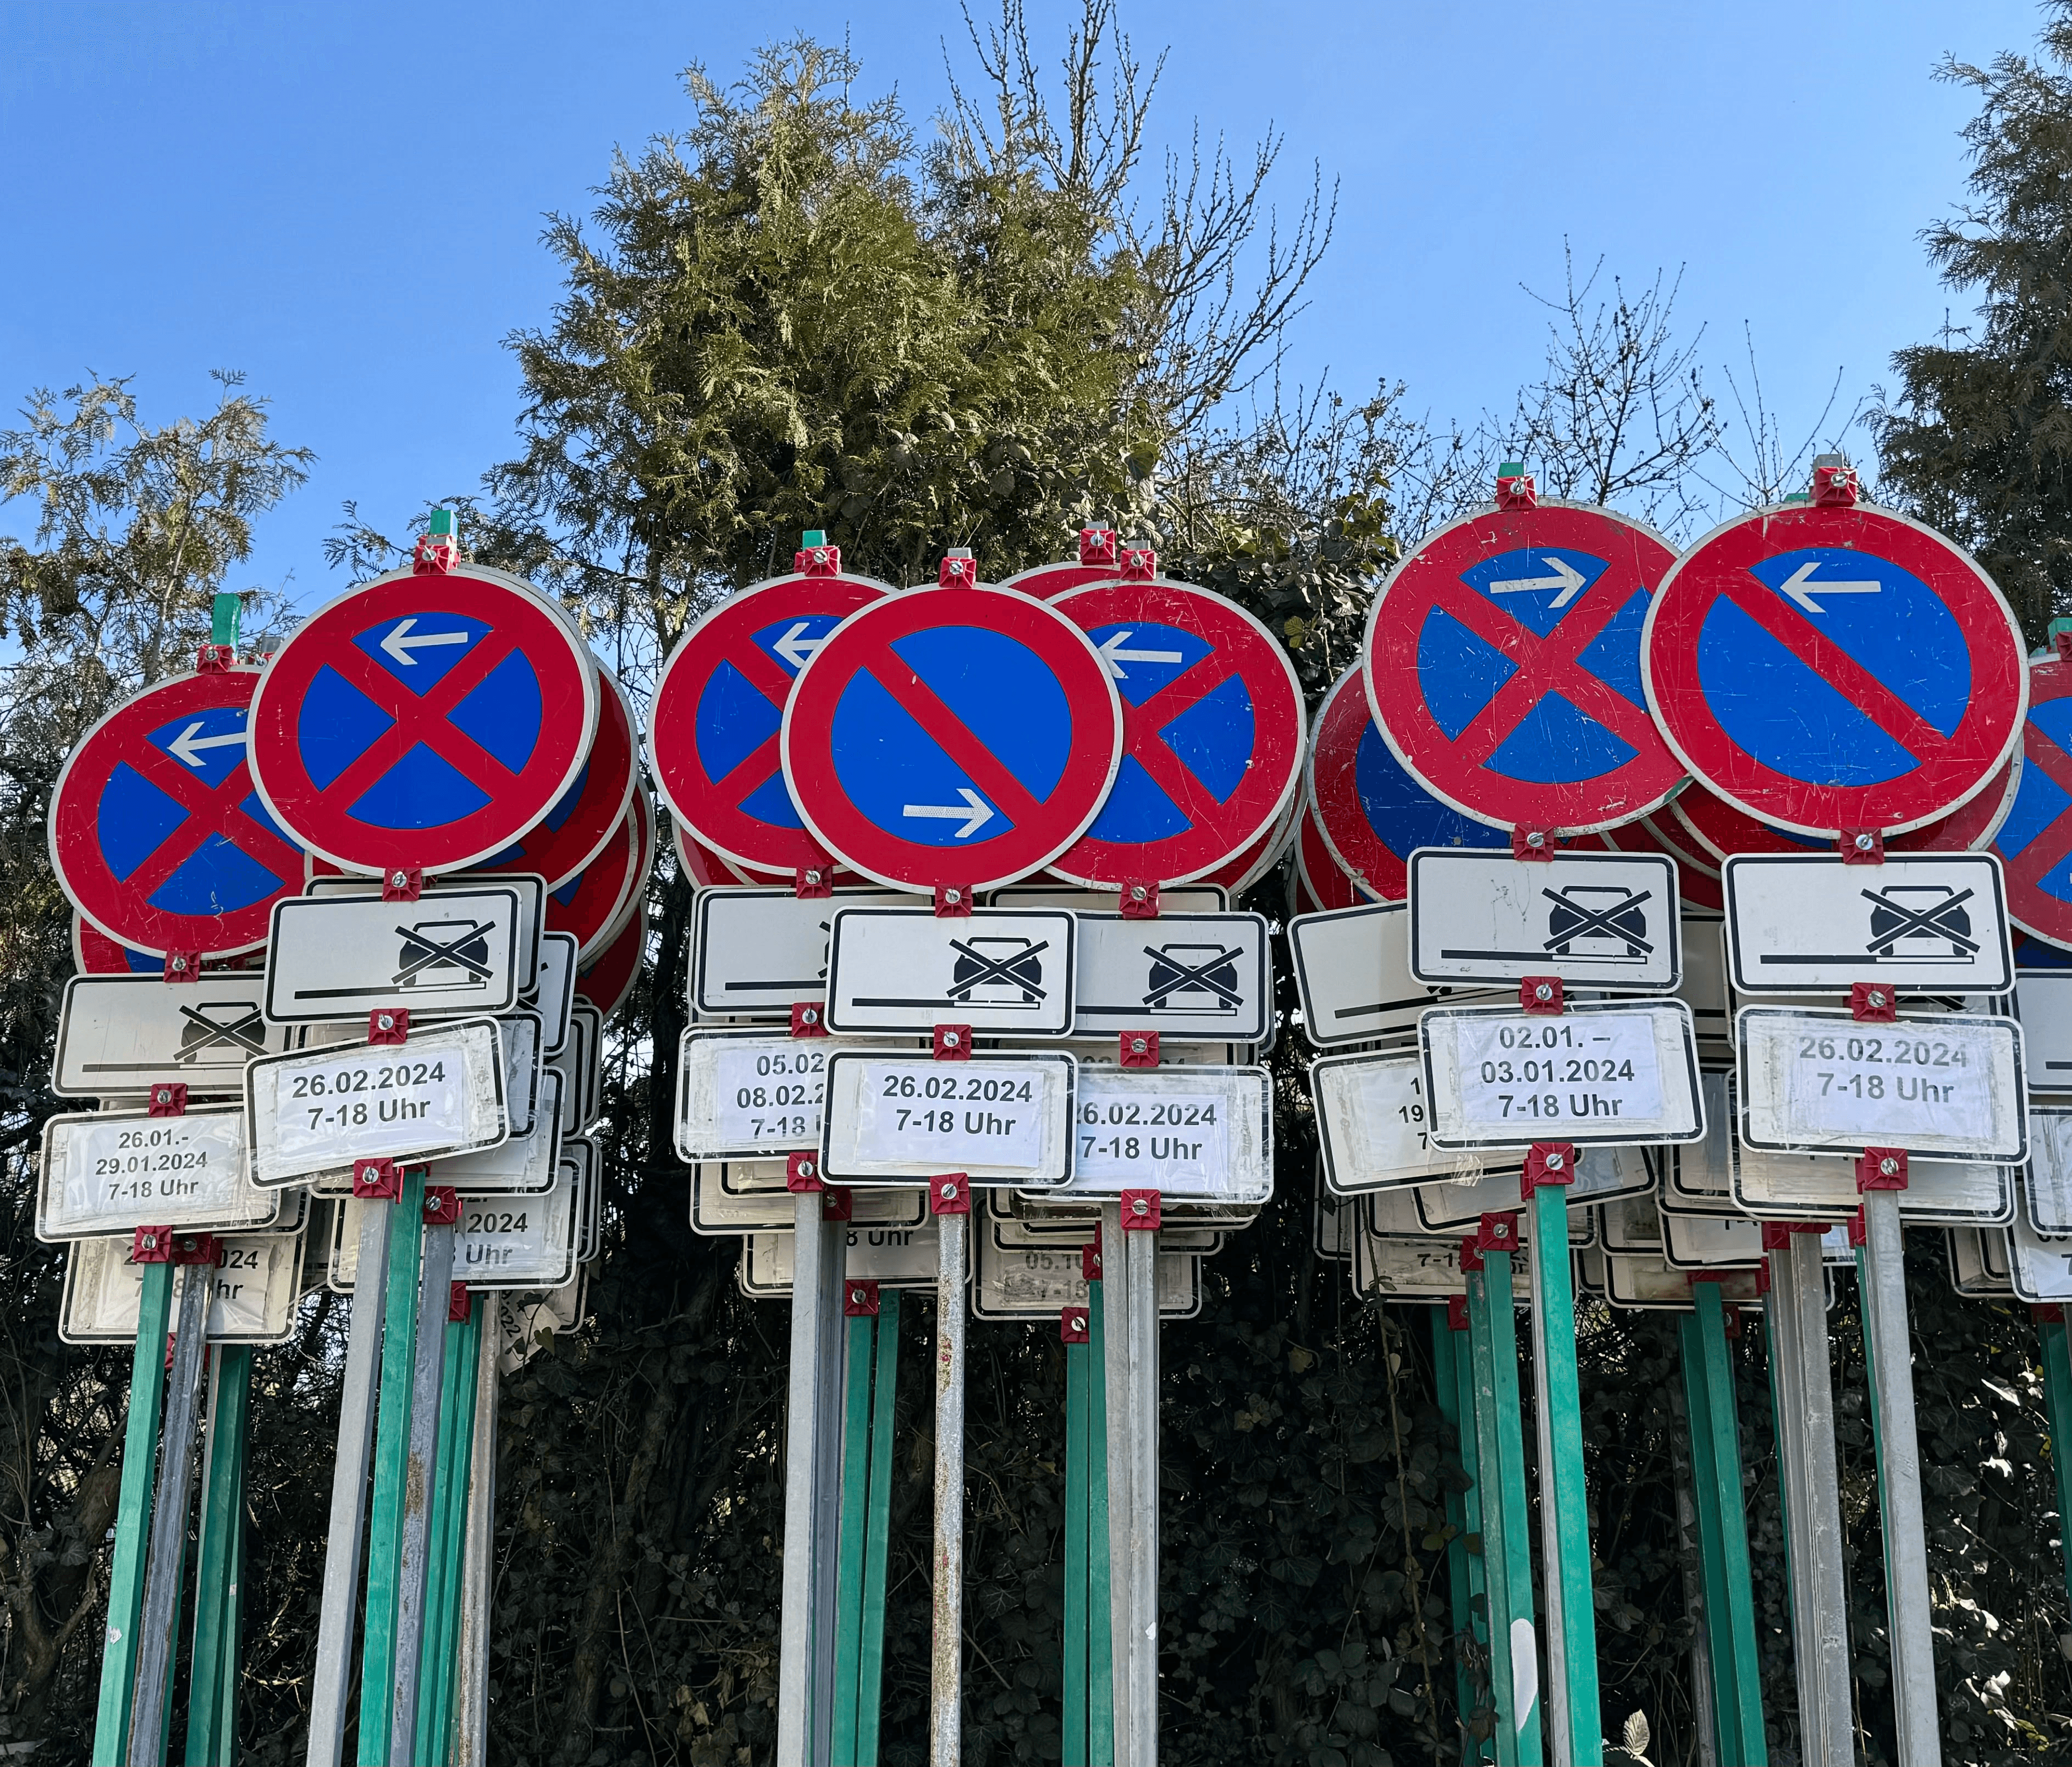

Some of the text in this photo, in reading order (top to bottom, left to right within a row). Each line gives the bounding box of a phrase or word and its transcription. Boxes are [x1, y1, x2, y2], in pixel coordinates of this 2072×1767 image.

[1499, 1025, 1583, 1049] 02.01.
[1799, 1036, 1968, 1067] 26.02.2024
[292, 1061, 446, 1098] 26.02.2024
[1481, 1059, 1635, 1083] 03.01.2024
[883, 1075, 1033, 1103] 26.02.2024
[1817, 1072, 1955, 1103] 7-18 Uhr
[307, 1098, 431, 1130] 7-18 Uhr
[1498, 1094, 1623, 1118] 7-18 Uhr
[751, 1116, 806, 1140] 7-18
[896, 1109, 1016, 1135] 7-18 Uhr
[118, 1129, 189, 1149] 26.01.-
[1081, 1136, 1203, 1160] 7-18 Uhr
[95, 1151, 208, 1176] 29.01.2024
[109, 1179, 199, 1200] 7-18 Uhr
[466, 1243, 513, 1265] Uhr
